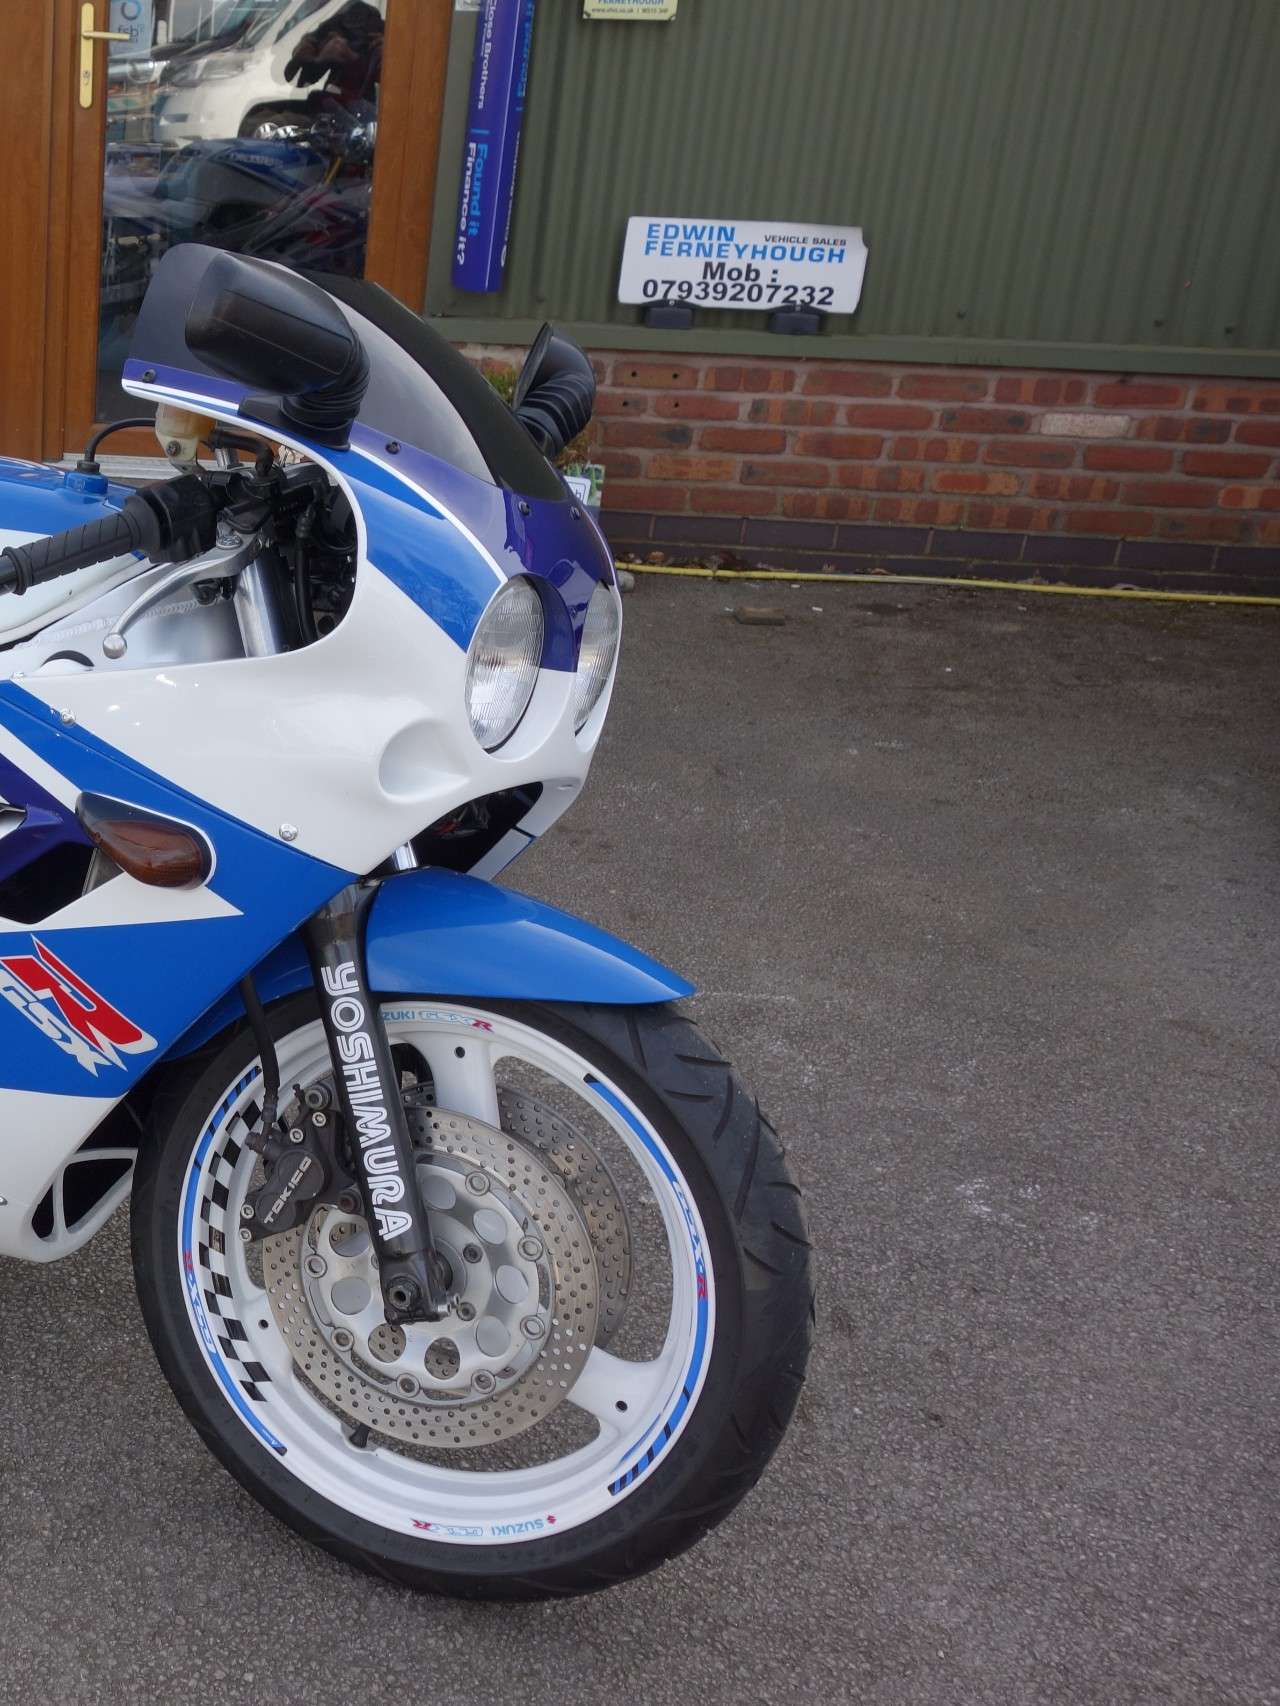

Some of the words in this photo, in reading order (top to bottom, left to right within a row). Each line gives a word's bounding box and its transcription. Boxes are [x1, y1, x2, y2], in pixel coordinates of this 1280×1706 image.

[478, 42, 492, 109] Brothers
[460, 142, 477, 231] Finance
[471, 143, 488, 216] Found
[468, 221, 480, 236] it
[647, 223, 736, 242] EDWIN
[765, 235, 809, 245] VEHICLE
[812, 237, 847, 246] SALES
[457, 236, 467, 265] it?
[644, 241, 845, 264] FERNEYHOUGH
[702, 261, 761, 282] Mob
[642, 279, 835, 306] 07939207232
[382, 1010, 416, 1021] ZUKI
[321, 961, 413, 1241] YOSHIMURA
[263, 1156, 312, 1224] TOKICO
[491, 1518, 545, 1537] SUZUKI
